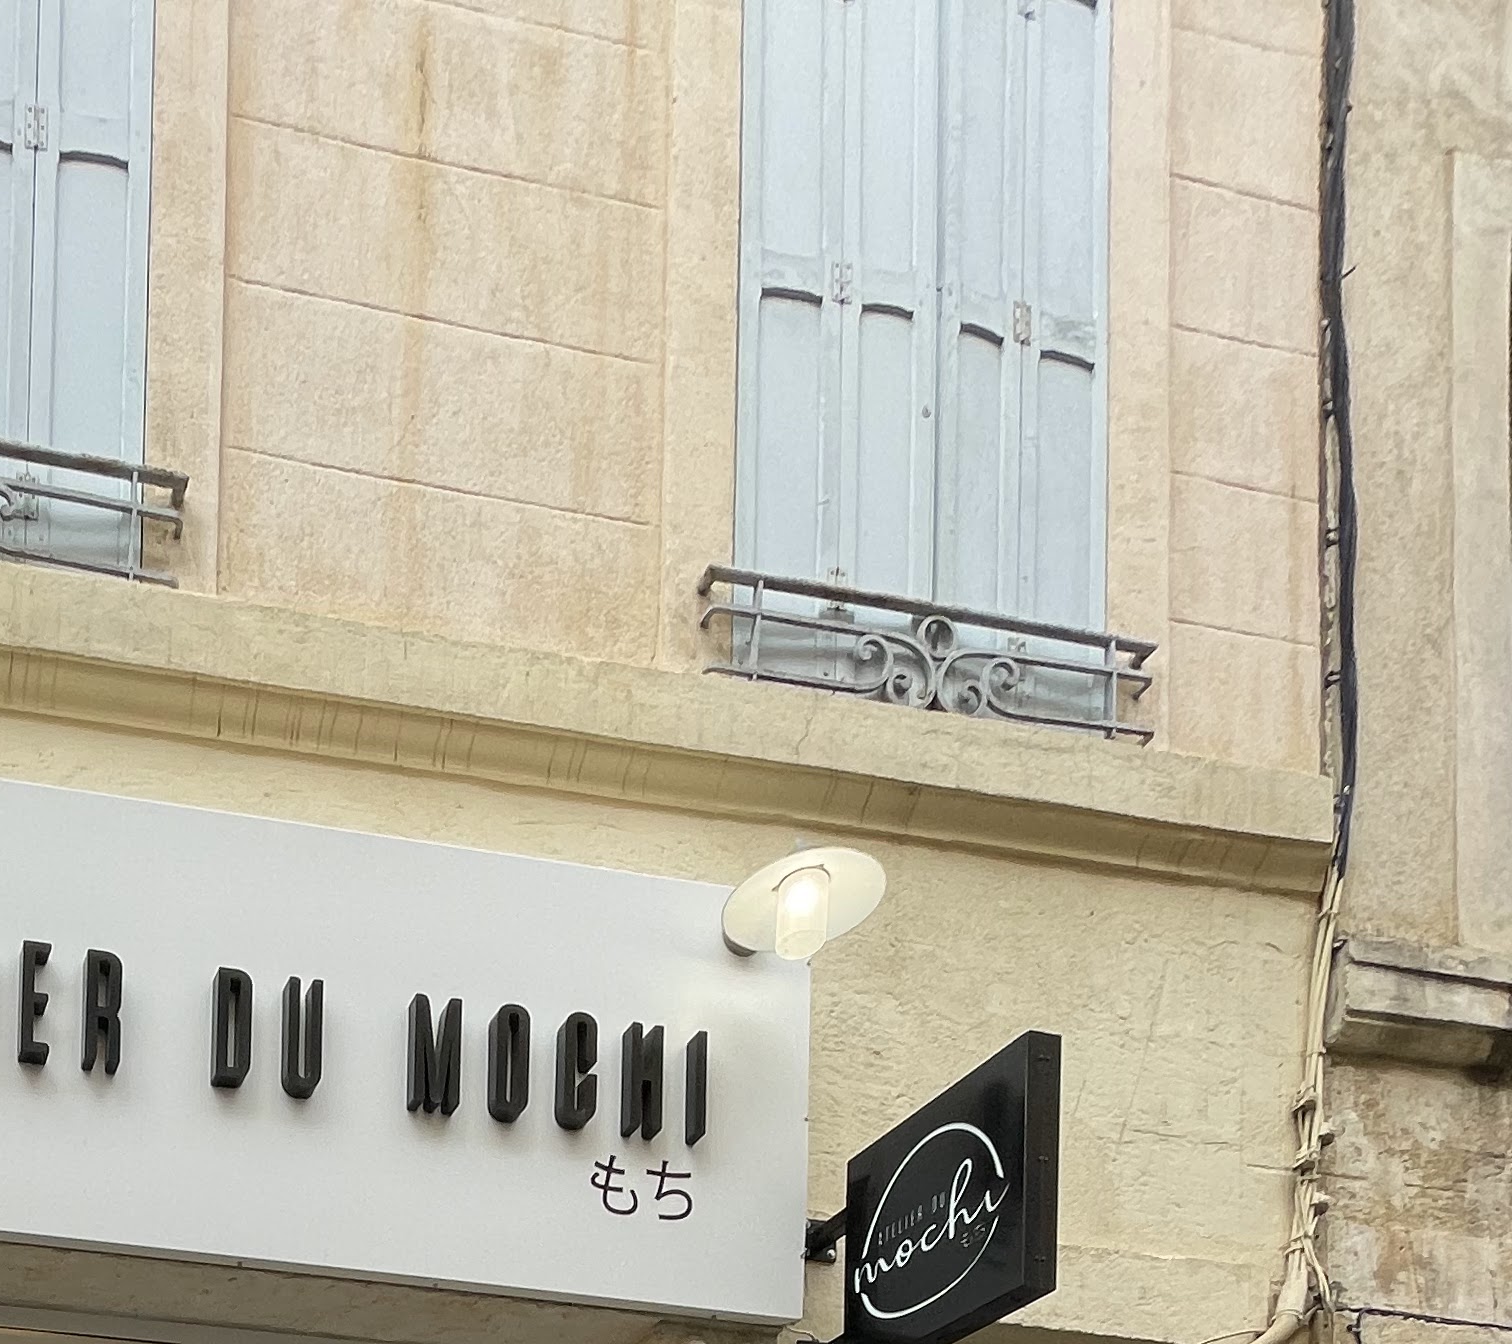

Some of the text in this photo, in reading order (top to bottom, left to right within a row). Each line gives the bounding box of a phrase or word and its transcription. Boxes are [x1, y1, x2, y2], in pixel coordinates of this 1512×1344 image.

[210, 966, 324, 1100] DU
[406, 992, 708, 1148] MOCHI
[590, 1154, 693, 1220] もち
[854, 1158, 1011, 1294] mochi
